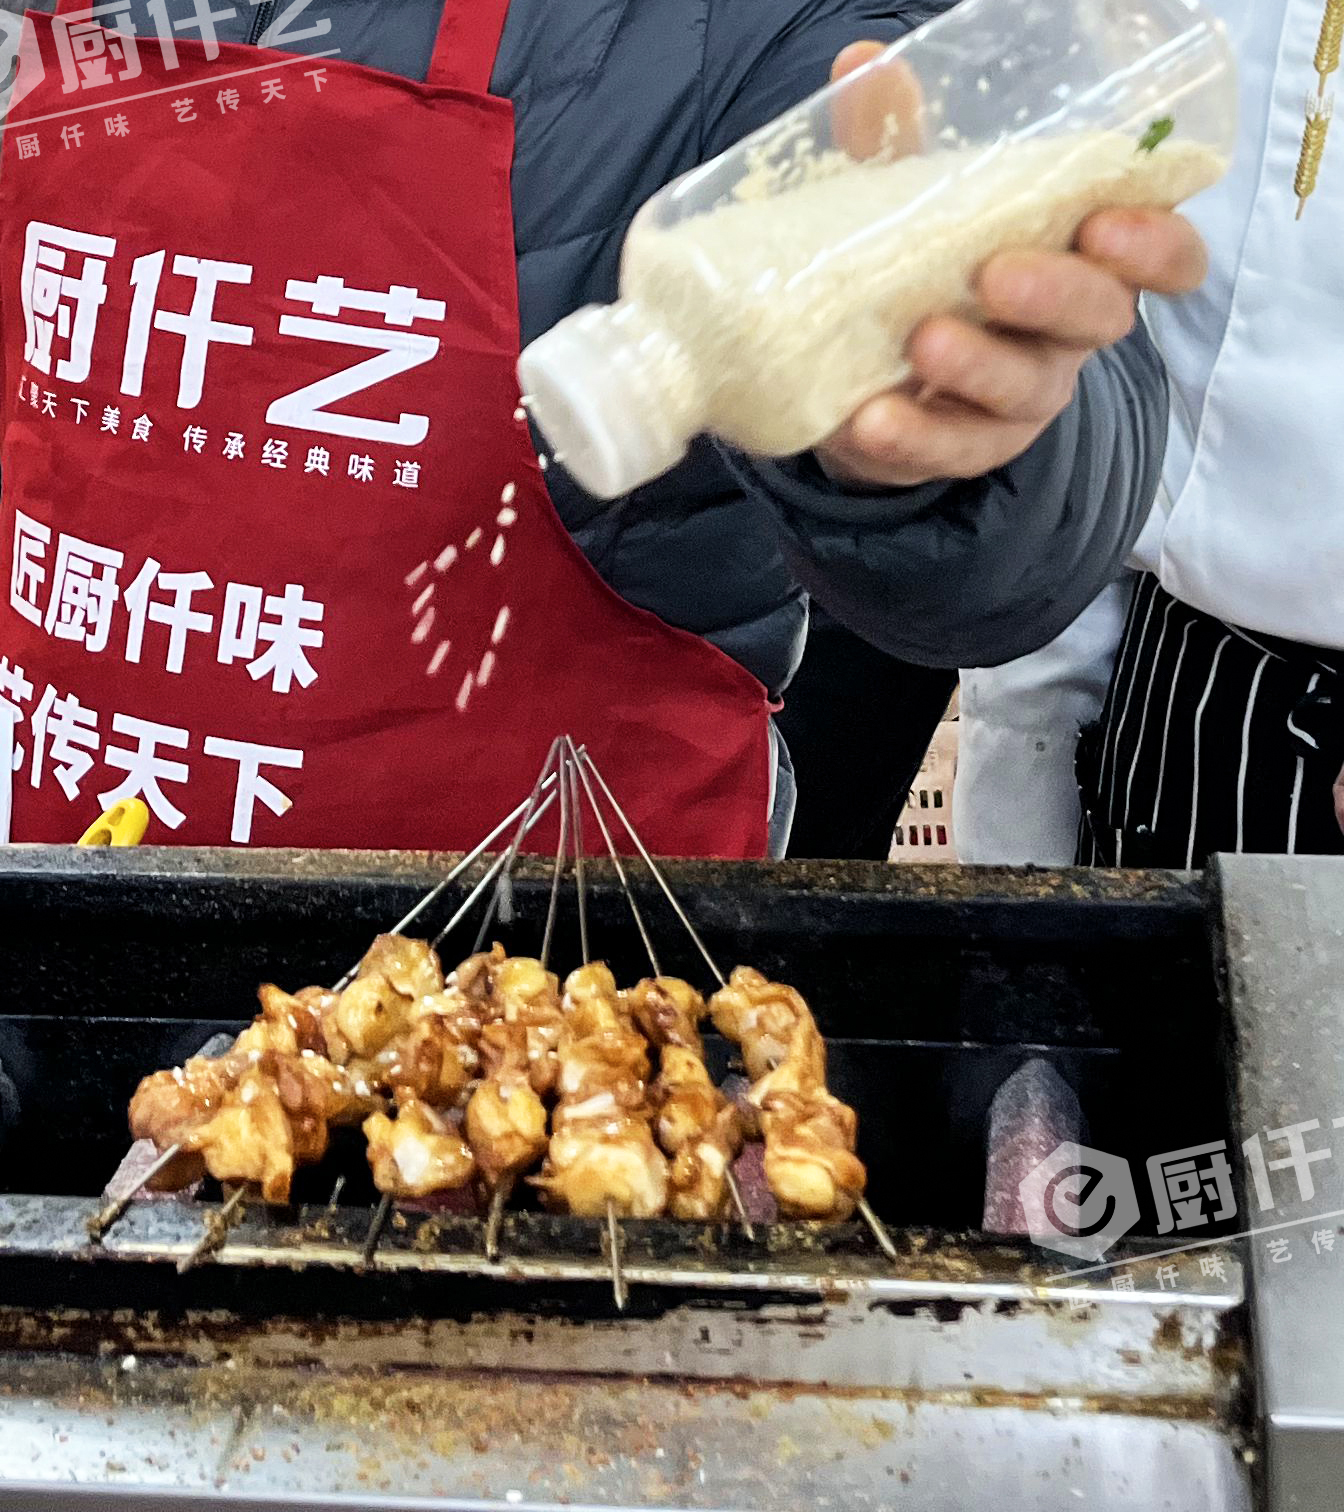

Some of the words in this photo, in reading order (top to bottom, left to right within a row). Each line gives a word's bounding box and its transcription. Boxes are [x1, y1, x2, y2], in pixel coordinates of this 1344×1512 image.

[22, 220, 446, 446] 厨仟艺
[182, 425, 422, 489] 传承经典味道
[10, 508, 326, 694] 匠厨仟味
